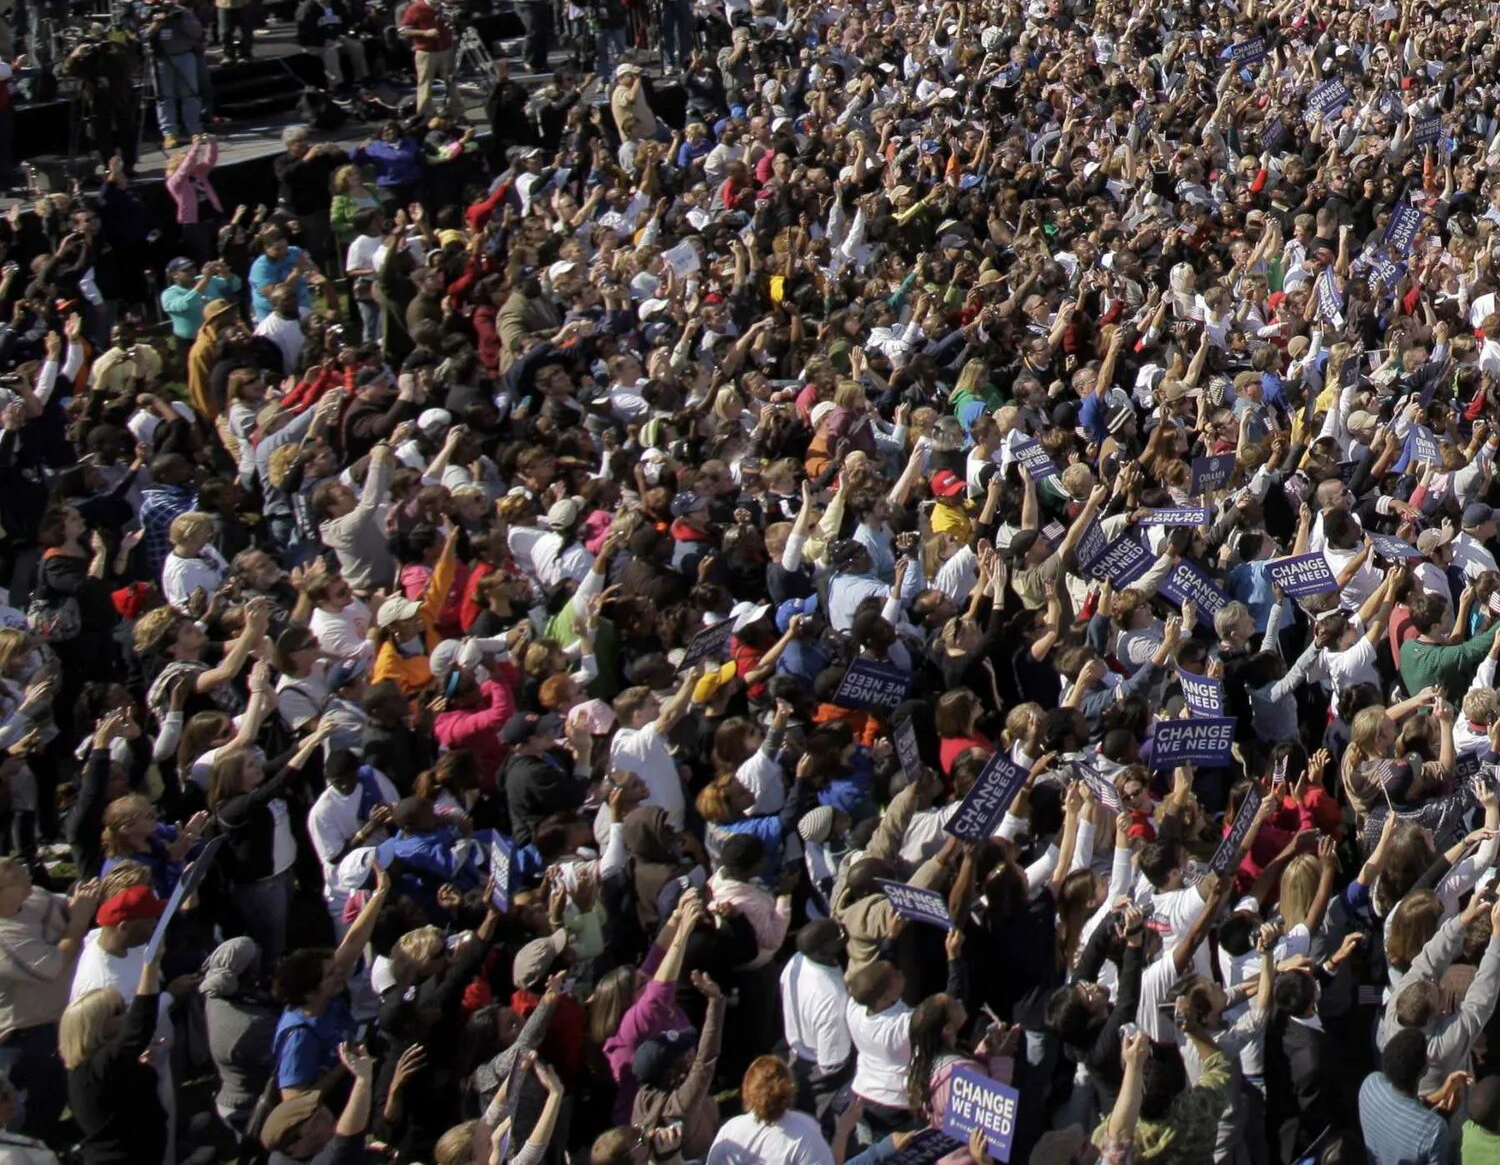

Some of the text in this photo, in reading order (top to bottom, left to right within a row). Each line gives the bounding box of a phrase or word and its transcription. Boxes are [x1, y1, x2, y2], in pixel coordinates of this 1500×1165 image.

[1233, 38, 1264, 55] CHANGE
[1311, 80, 1342, 104] CHANGE
[1396, 210, 1420, 250] CHANGE
[1015, 444, 1044, 462] CHANGE
[1091, 537, 1137, 577] CHANGE
[1117, 545, 1144, 570] NEED
[1271, 556, 1325, 579] CHANGE
[1176, 564, 1225, 608] CHANGE
[1298, 566, 1330, 584] NEED
[1171, 572, 1218, 616] WE NEED
[846, 672, 907, 695] WE NEED
[841, 686, 902, 707] CHANGE
[1187, 693, 1219, 710] NEED
[1157, 724, 1232, 742] CHANGE
[1155, 737, 1229, 755] WE NEED
[954, 758, 1010, 834] CHANGE
[988, 765, 1016, 810] NEED
[952, 1076, 1014, 1120] CHANGE
[951, 1094, 972, 1120] WE
[974, 1106, 1011, 1136] NEED
